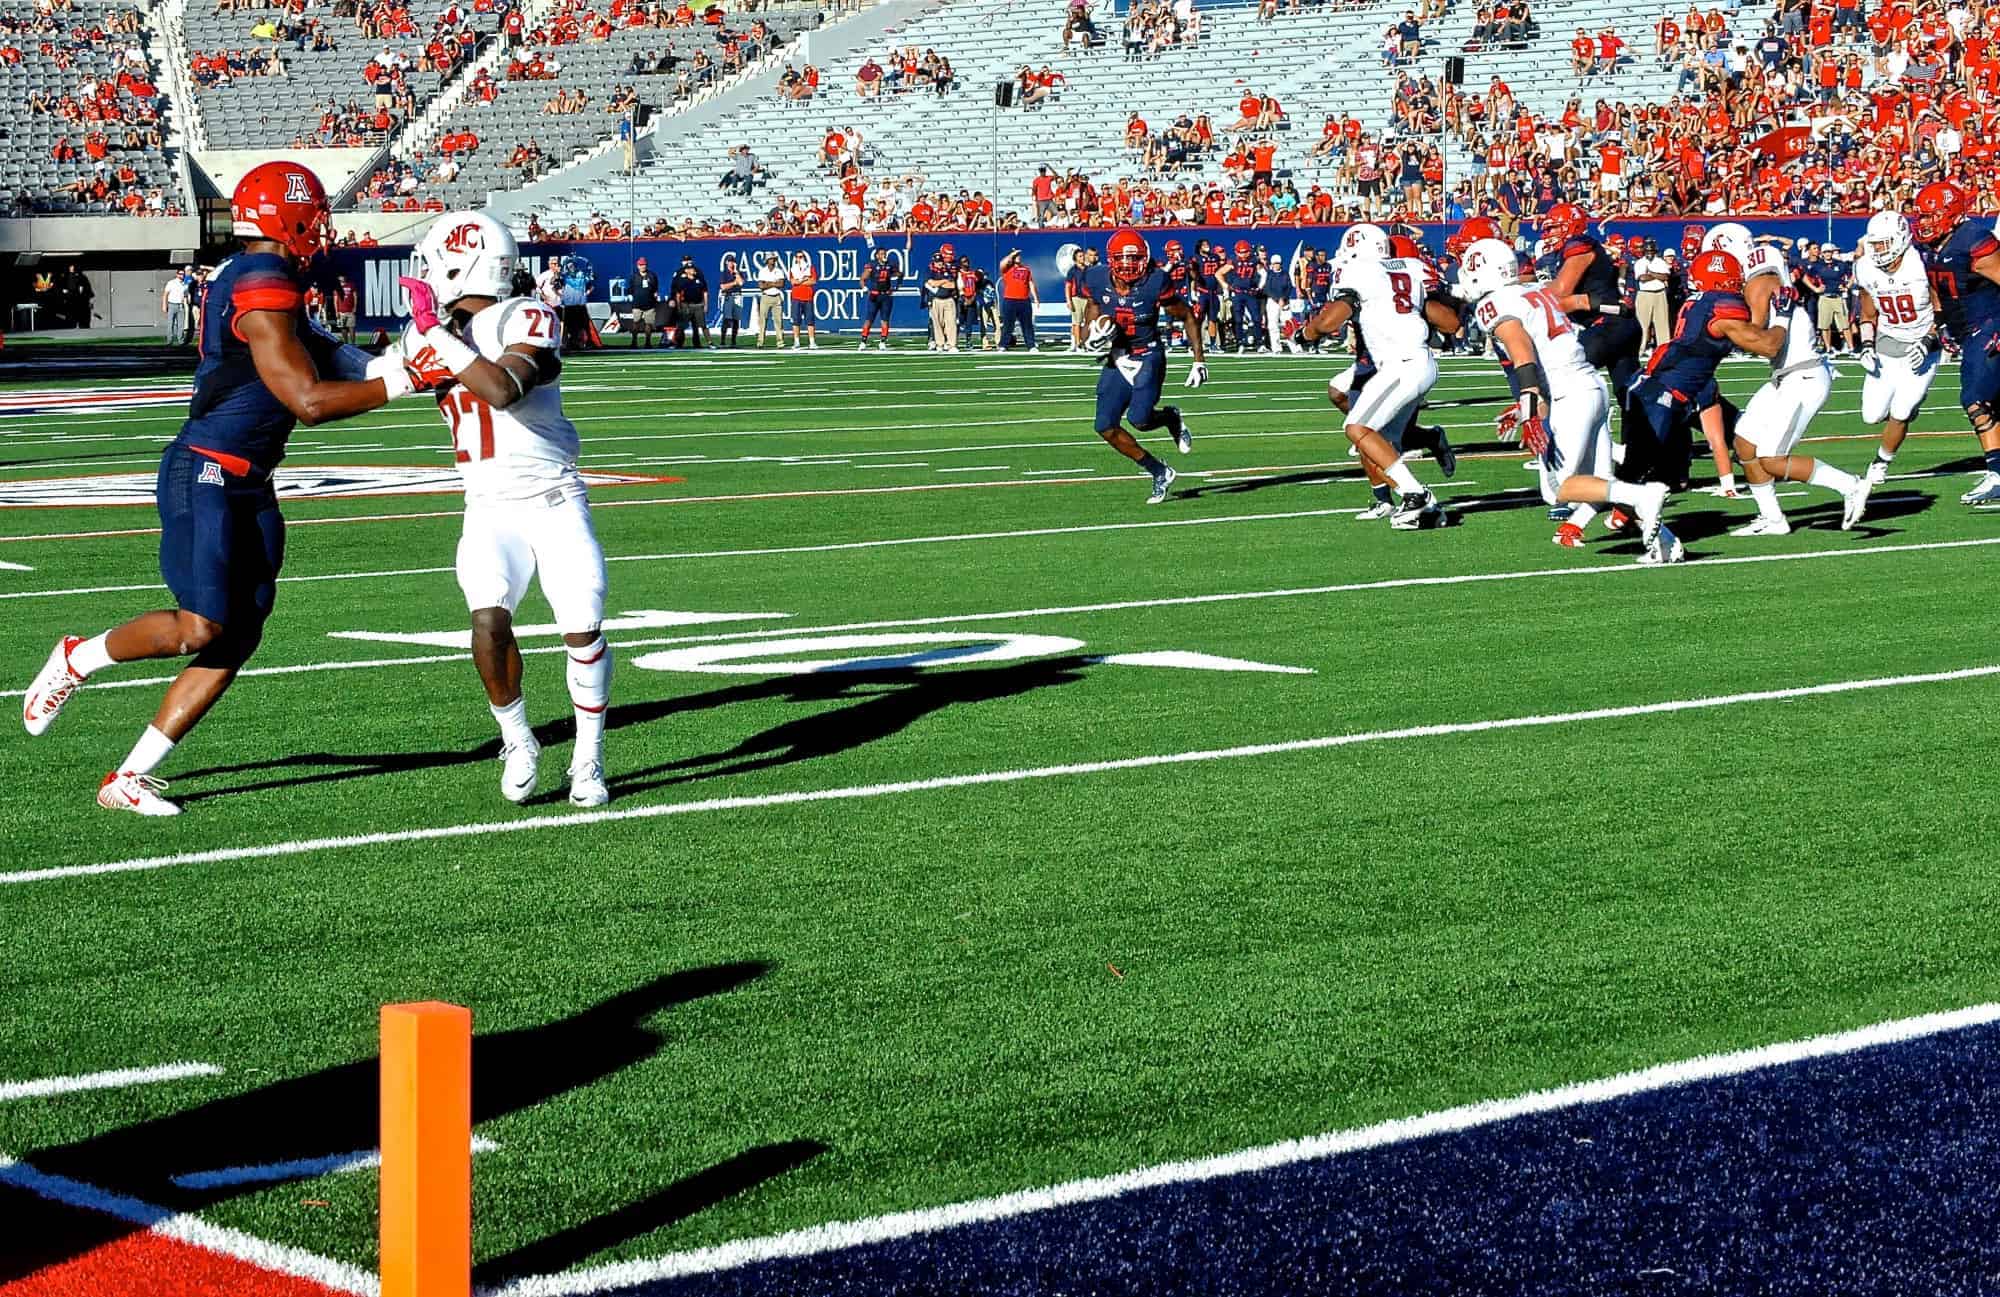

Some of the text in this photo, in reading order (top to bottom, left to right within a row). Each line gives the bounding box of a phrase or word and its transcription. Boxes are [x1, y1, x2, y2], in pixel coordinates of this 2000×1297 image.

[285, 173, 312, 203] A
[720, 249, 918, 281] CASNO DEL OL
[1386, 271, 1413, 314] 8
[524, 309, 556, 339] 27
[1477, 300, 1498, 326] 29
[1878, 294, 1917, 325] 99
[198, 461, 225, 486] A
